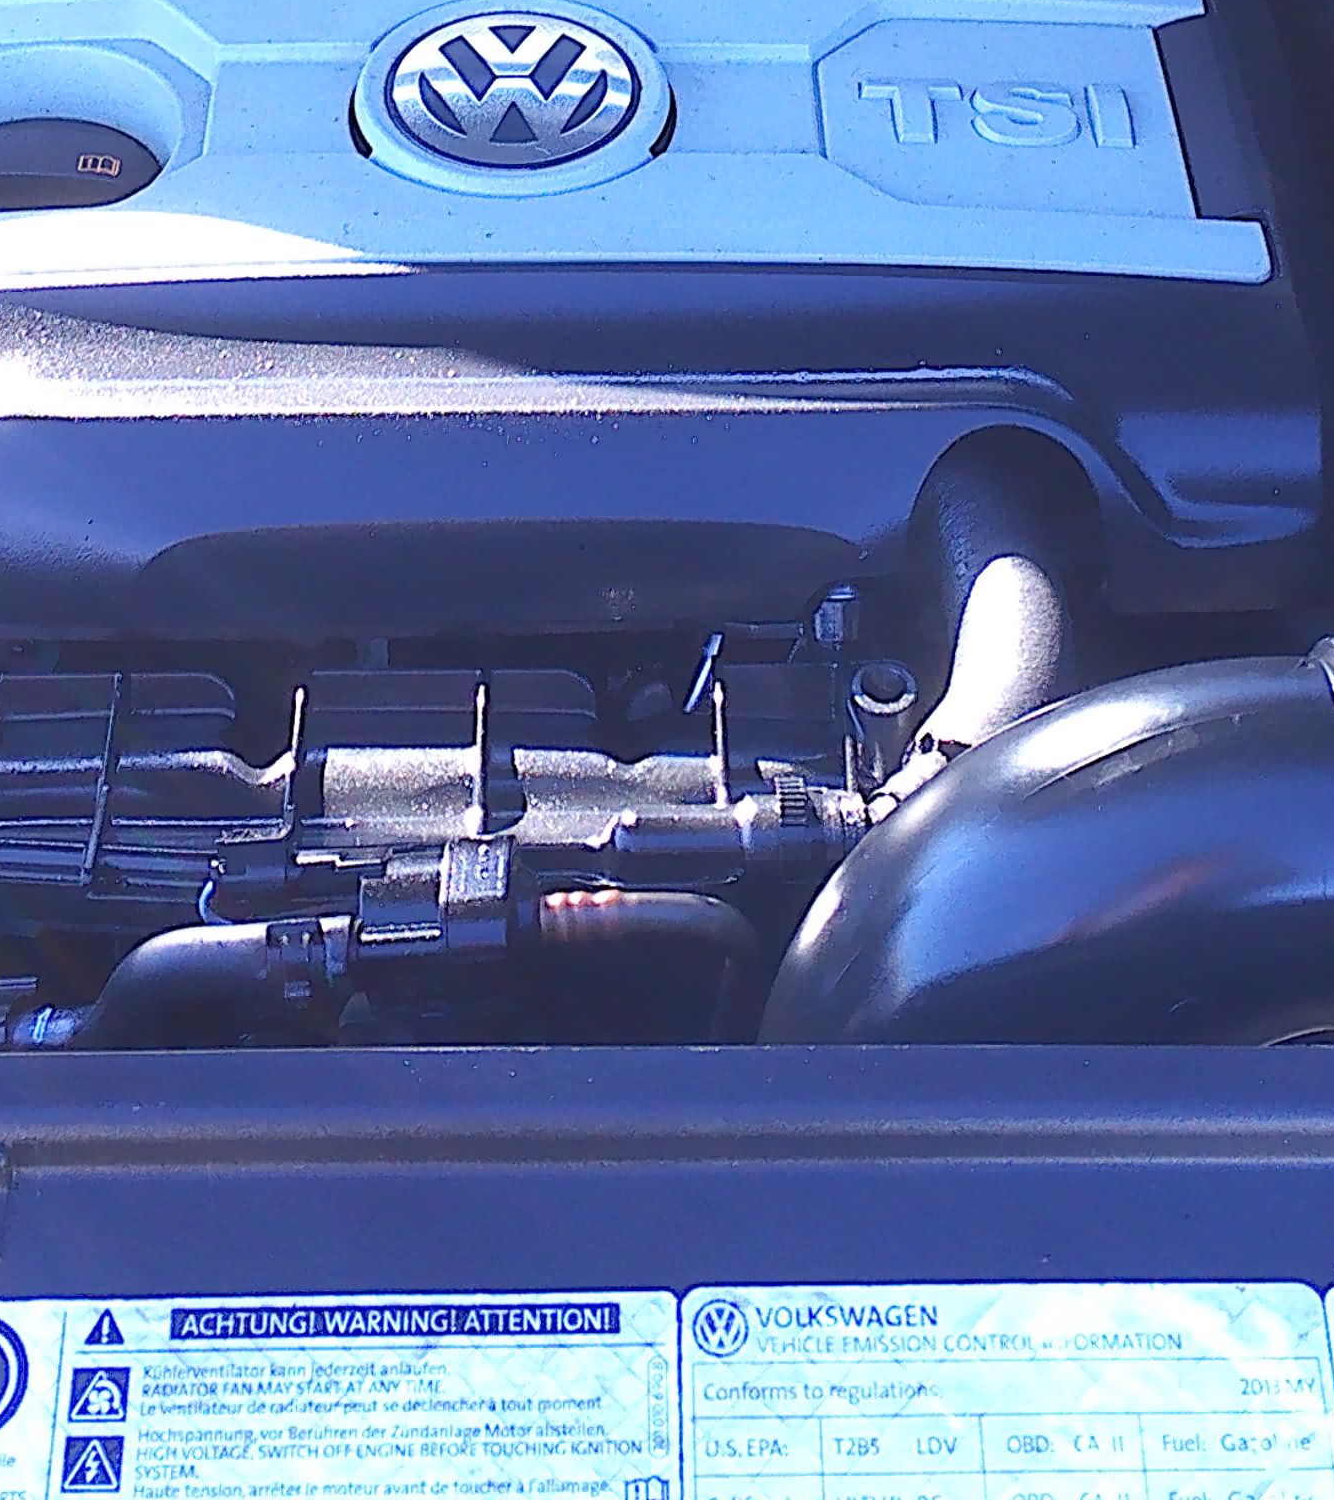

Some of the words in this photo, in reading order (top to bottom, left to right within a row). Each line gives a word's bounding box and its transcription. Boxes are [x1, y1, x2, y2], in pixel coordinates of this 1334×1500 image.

[855, 80, 1138, 148] TSI
[181, 1311, 316, 1336] ACHTUNG!
[323, 1309, 457, 1333] WARNING!
[463, 1307, 611, 1332] ATTENTION!
[755, 1304, 938, 1329] VOLKSWAGEN
[757, 1335, 835, 1353] VEHICLE
[842, 1334, 936, 1352] EMISSION
[943, 1333, 1033, 1352] CONTROL
[270, 1362, 305, 1378] kann
[142, 1382, 218, 1397] RADIATOR
[222, 1381, 252, 1397] FAN
[257, 1381, 293, 1397] MAY
[297, 1379, 342, 1396] START
[345, 1380, 363, 1395] AT
[369, 1379, 401, 1394] ANY
[703, 1380, 797, 1402] Conforms
[803, 1383, 824, 1401] to
[140, 1402, 156, 1417] Le
[160, 1400, 242, 1416] ventilateur
[247, 1400, 267, 1415] de
[343, 1400, 378, 1418] peut
[383, 1400, 399, 1413] se
[501, 1398, 533, 1412] tout
[259, 1429, 284, 1441] vor
[361, 1424, 388, 1440] der
[484, 1422, 533, 1438] Motor
[136, 1445, 177, 1462] HIGH
[259, 1444, 319, 1461] SWITCH
[324, 1443, 352, 1460] OFF
[356, 1443, 413, 1461] ENGINE
[421, 1442, 476, 1458] BEFORE
[484, 1442, 567, 1459] TOUCHING
[571, 1440, 643, 1457] IGNITION
[704, 1436, 742, 1458] U.S.
[746, 1436, 788, 1457] EPA:
[832, 1436, 880, 1457] T2B5
[916, 1435, 958, 1456] LDV
[1006, 1434, 1055, 1454] OBD:
[1073, 1434, 1100, 1453] CA
[133, 1484, 180, 1499] Haute
[305, 1482, 318, 1496] le
[322, 1481, 379, 1496] moteur
[384, 1480, 426, 1495] avant
[430, 1481, 449, 1496] de
[453, 1479, 512, 1495] toucher
